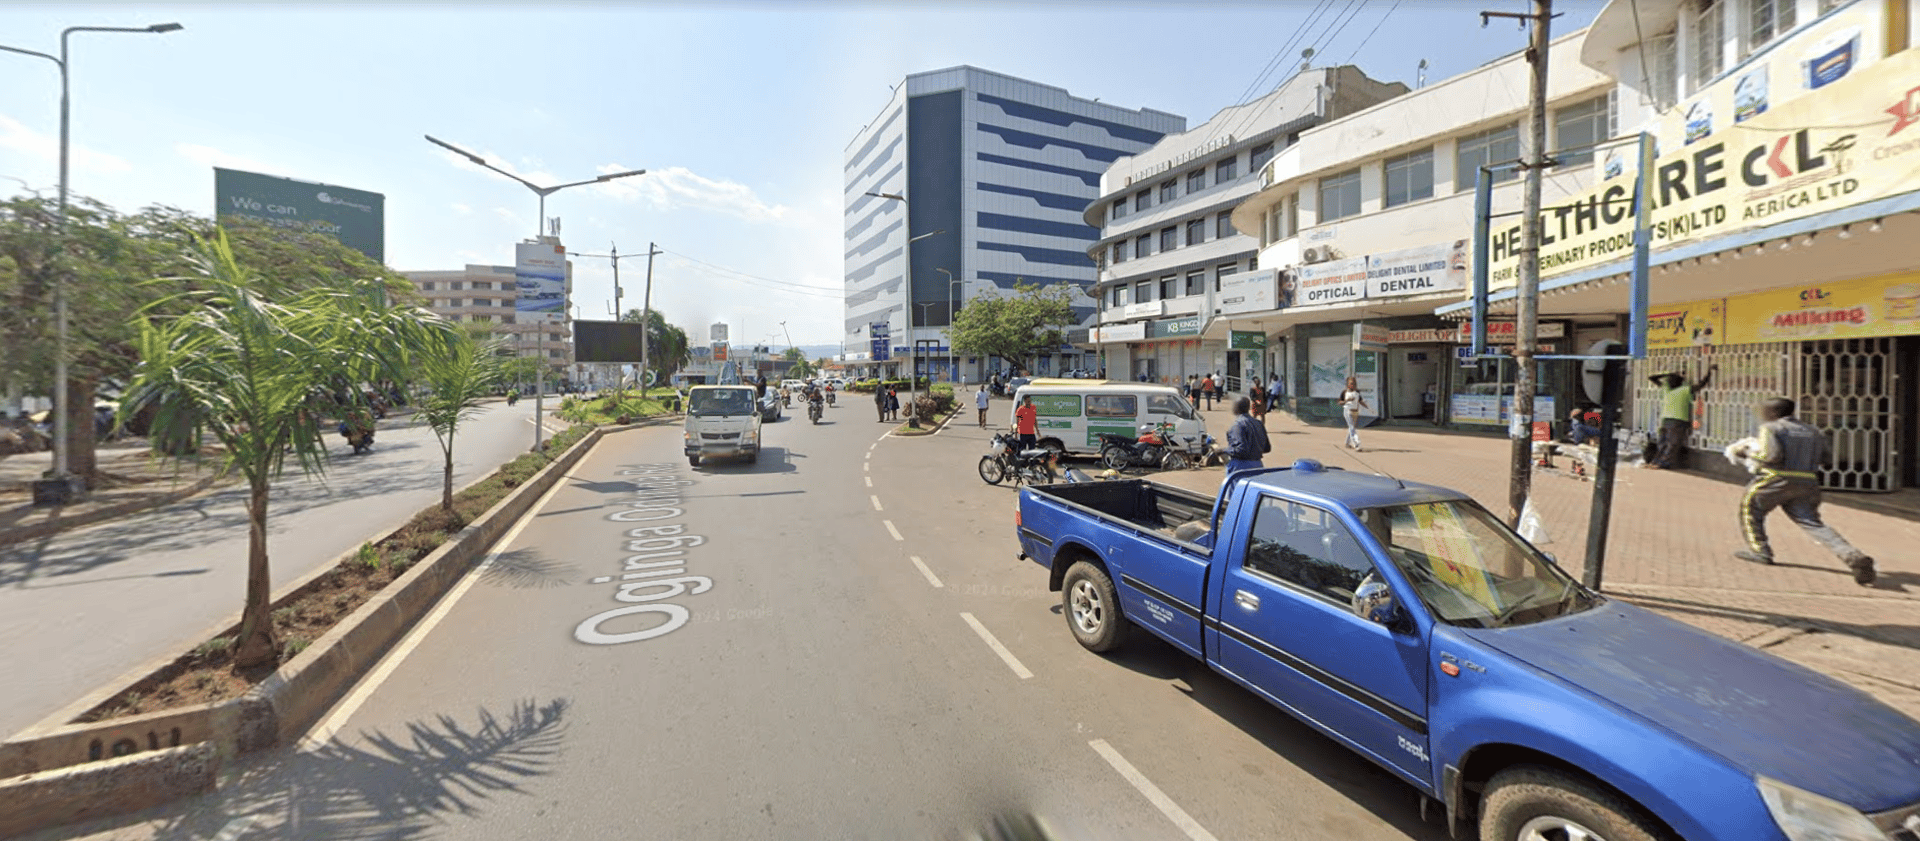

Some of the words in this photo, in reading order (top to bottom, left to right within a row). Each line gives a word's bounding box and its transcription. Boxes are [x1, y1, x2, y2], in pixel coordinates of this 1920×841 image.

[1816, 178, 1859, 201] LTD
[231, 196, 262, 210] We
[266, 203, 298, 215] can
[1492, 142, 1727, 264] HELTHCRE
[1540, 244, 1586, 271] ERINARY
[1367, 267, 1393, 280] DELIGHT
[1394, 264, 1417, 277] DENTAL
[1380, 276, 1435, 293] DENTAL
[1308, 286, 1357, 301] OPTICAL
[1167, 321, 1179, 334] KB
[1389, 330, 1435, 343] DELIGHT
